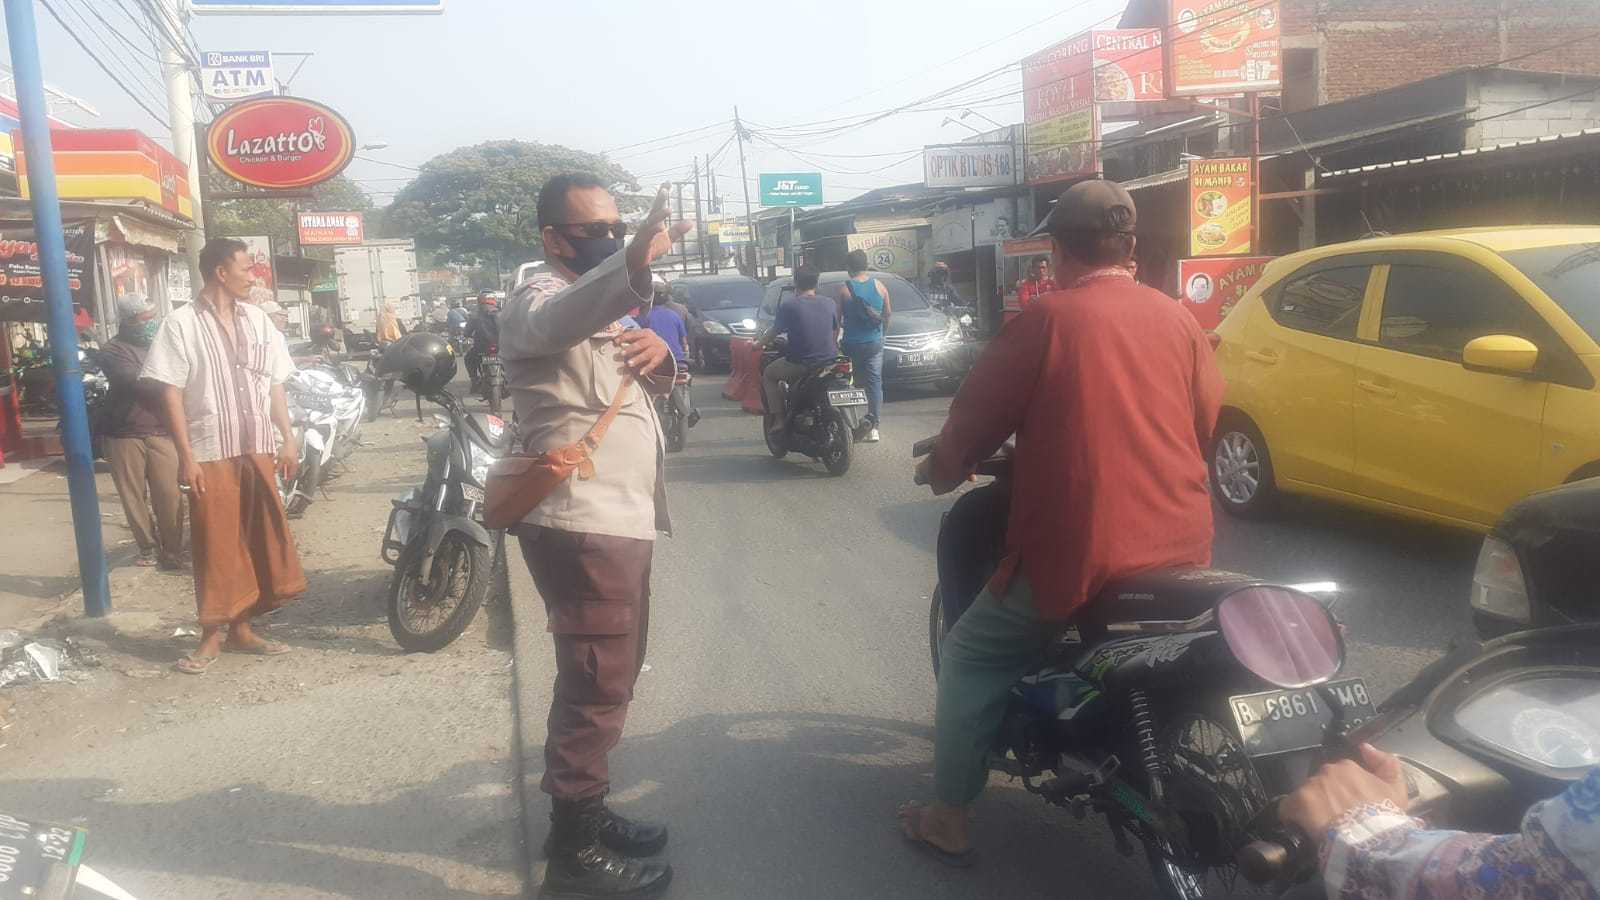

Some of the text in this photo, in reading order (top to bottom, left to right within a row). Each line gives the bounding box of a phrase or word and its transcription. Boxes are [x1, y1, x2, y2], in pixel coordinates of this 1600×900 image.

[1096, 34, 1149, 50] CENTRAL
[212, 69, 266, 87] ATM
[226, 127, 314, 156] Lazatto
[277, 154, 302, 163] Burger
[930, 155, 960, 177] OPTIK
[1193, 162, 1218, 175] AYAM
[878, 252, 891, 264] 24
[1219, 263, 1256, 291] AYAM
[1238, 702, 1254, 726] B
[1327, 683, 1370, 707] MB
